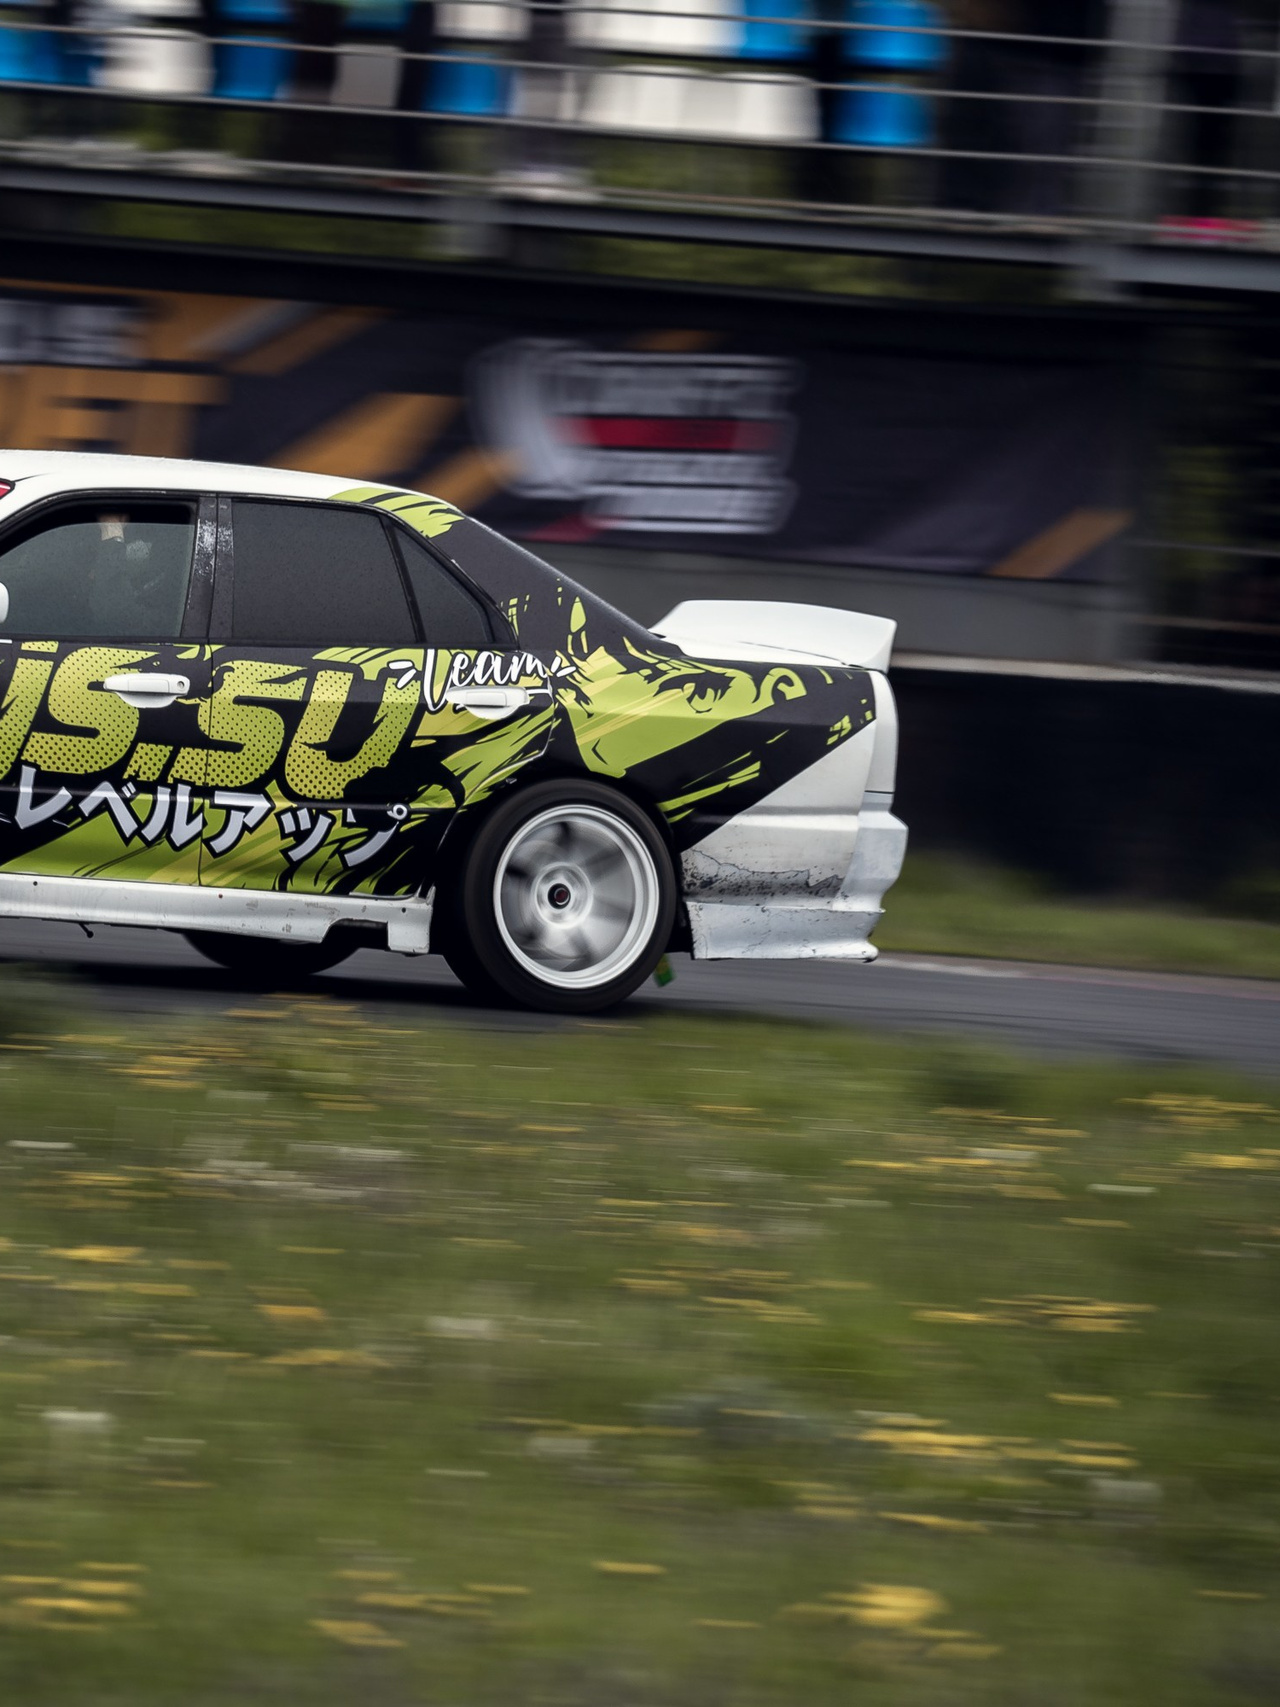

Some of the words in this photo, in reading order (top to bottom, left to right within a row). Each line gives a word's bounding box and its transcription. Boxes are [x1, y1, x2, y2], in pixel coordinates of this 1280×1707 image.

[14, 763, 408, 867] レベルアップ
